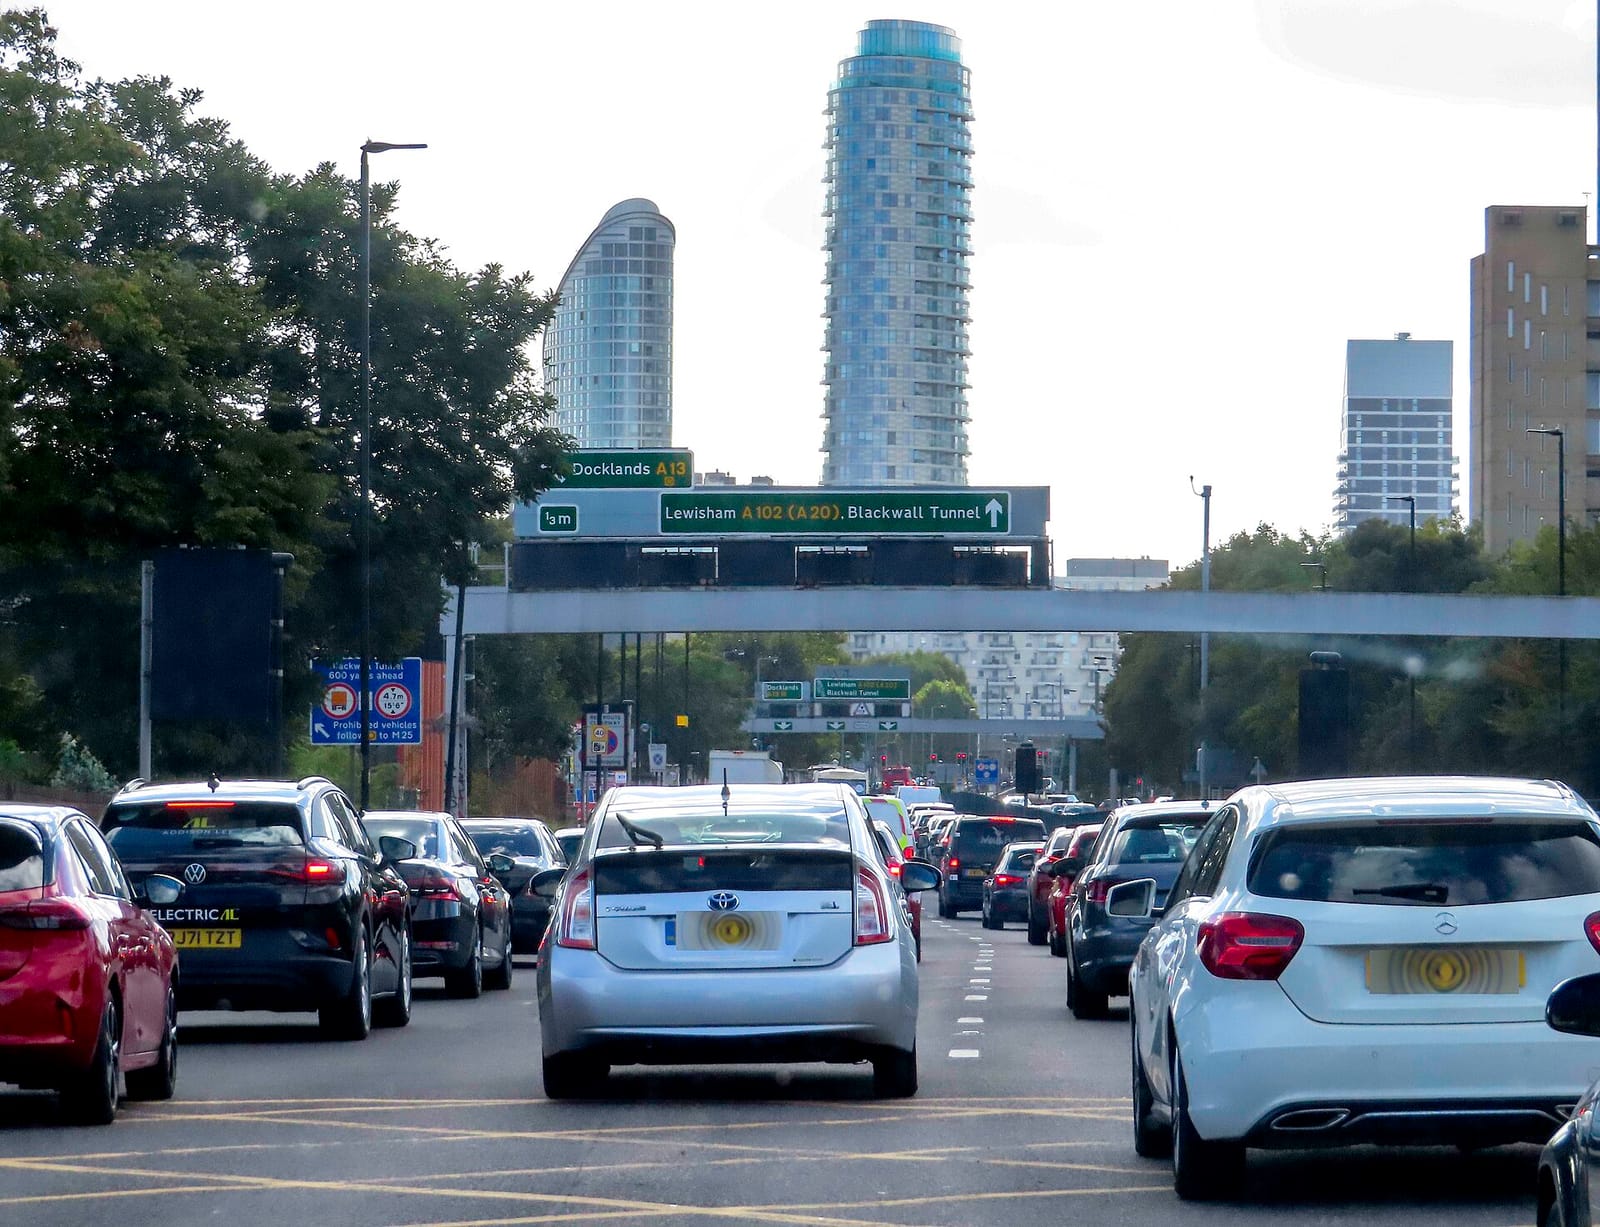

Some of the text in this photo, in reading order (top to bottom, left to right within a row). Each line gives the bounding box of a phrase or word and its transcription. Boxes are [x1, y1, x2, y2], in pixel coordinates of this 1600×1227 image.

[572, 462, 686, 476] Docklands A13
[665, 506, 736, 519] Lewisham
[848, 506, 924, 519] Blackwall
[929, 506, 981, 519] Tunnel
[329, 671, 404, 680] 600 yas ahead
[333, 721, 417, 729] Prohibed vehicles
[380, 731, 388, 739] to
[206, 930, 236, 944] TZT
